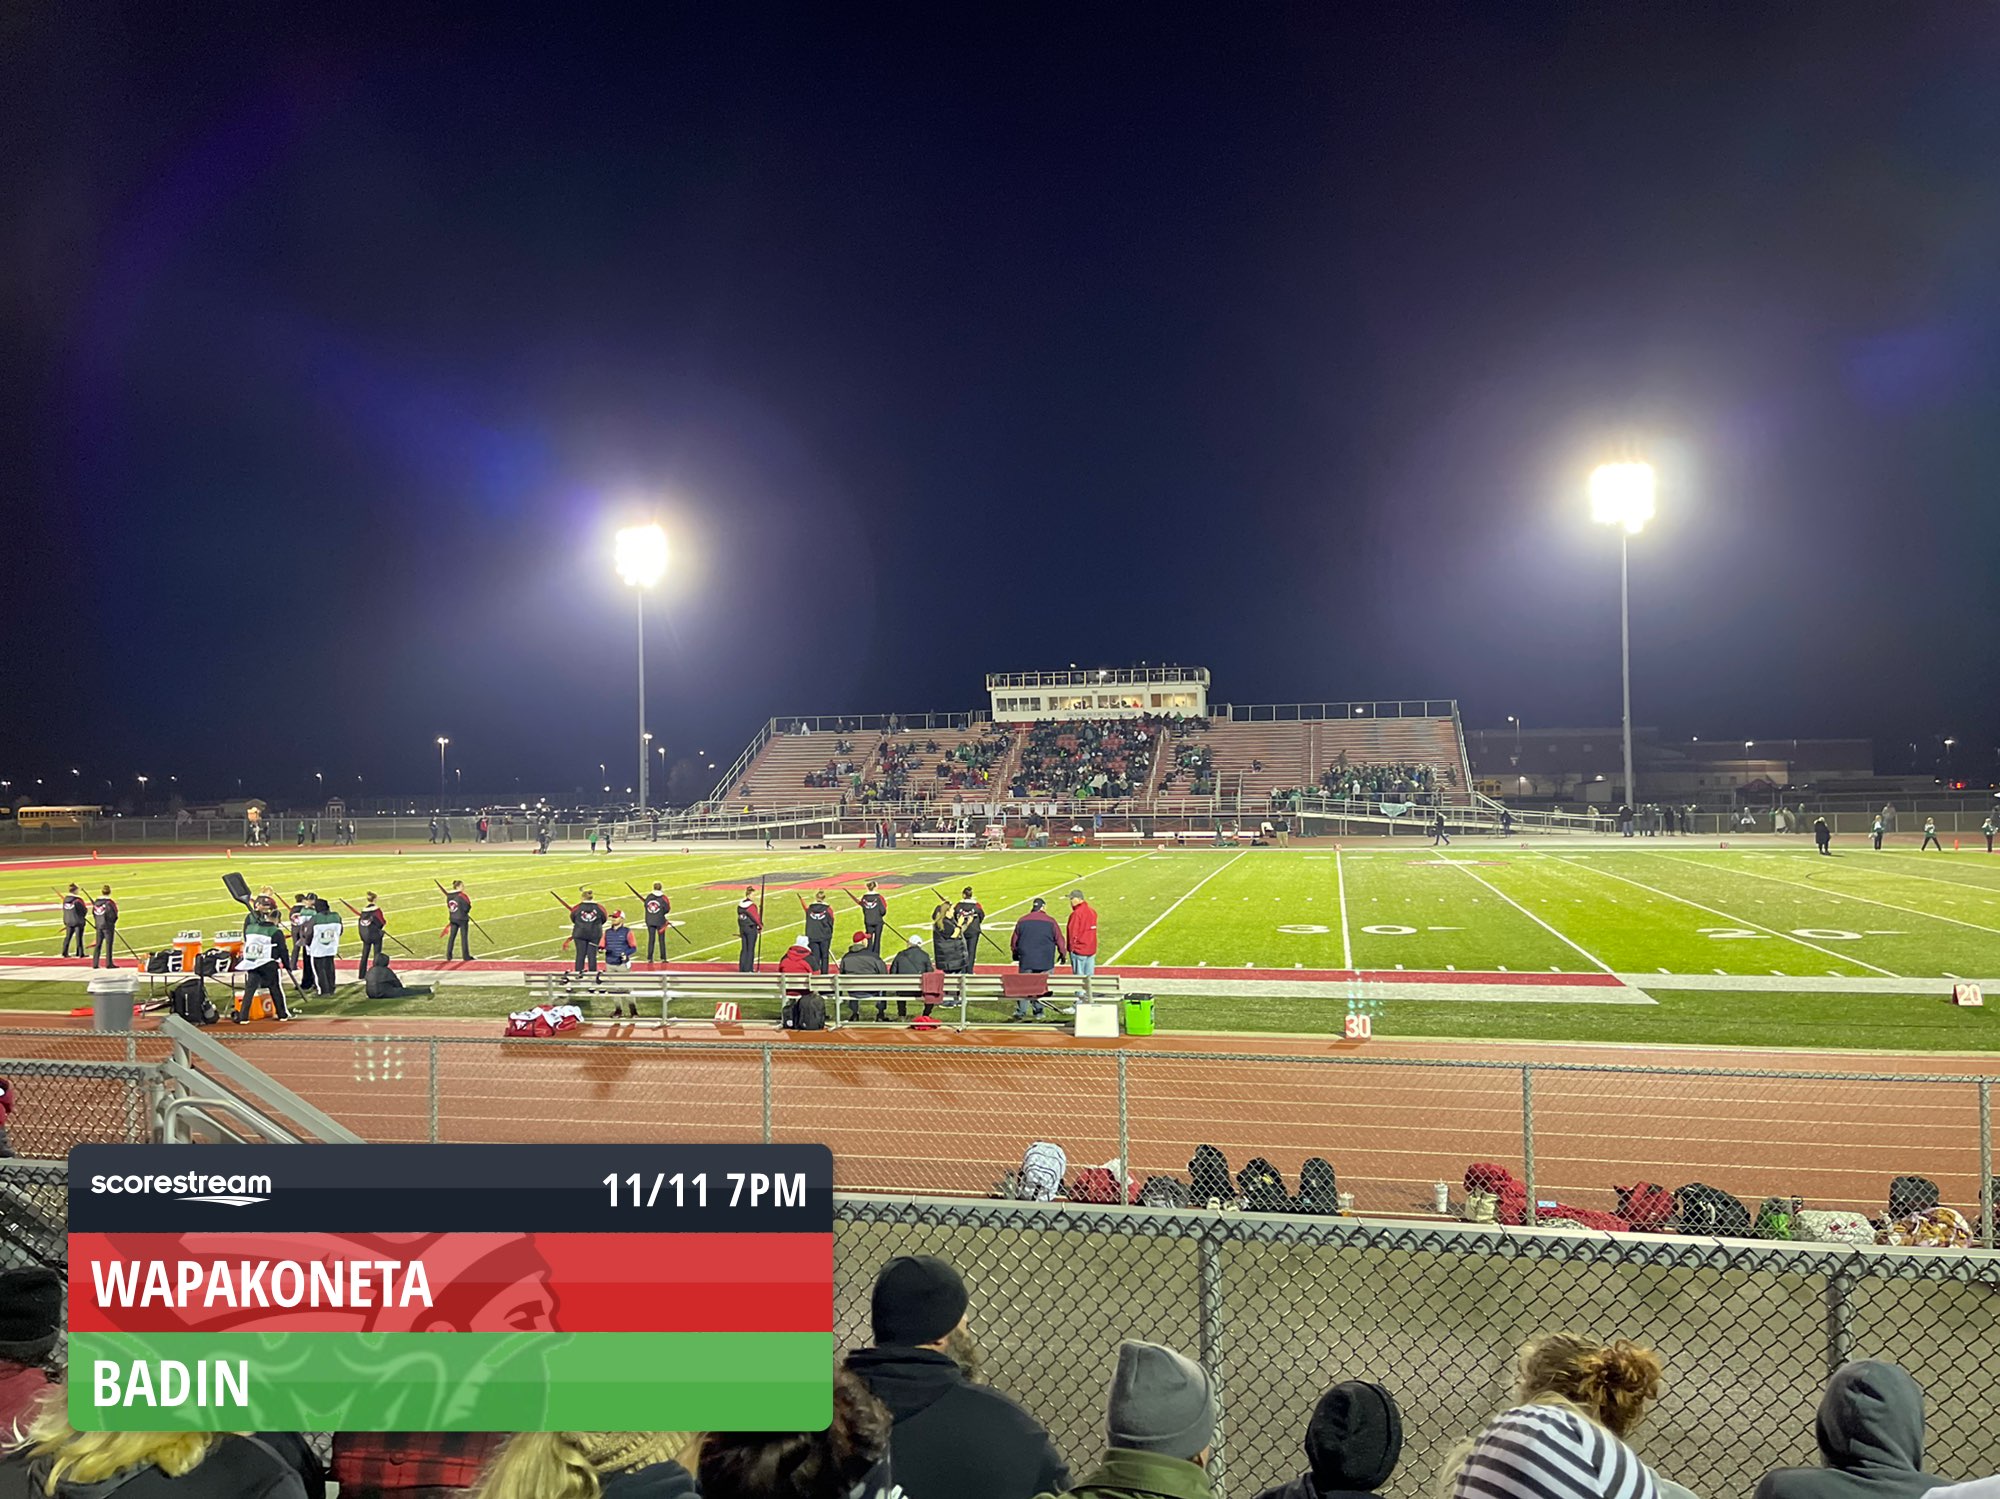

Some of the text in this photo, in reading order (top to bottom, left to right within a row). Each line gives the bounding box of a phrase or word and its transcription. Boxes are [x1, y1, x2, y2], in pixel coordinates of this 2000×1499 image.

[1956, 984, 1983, 1006] 20
[715, 1002, 738, 1021] 40
[1345, 1014, 1371, 1038] 30
